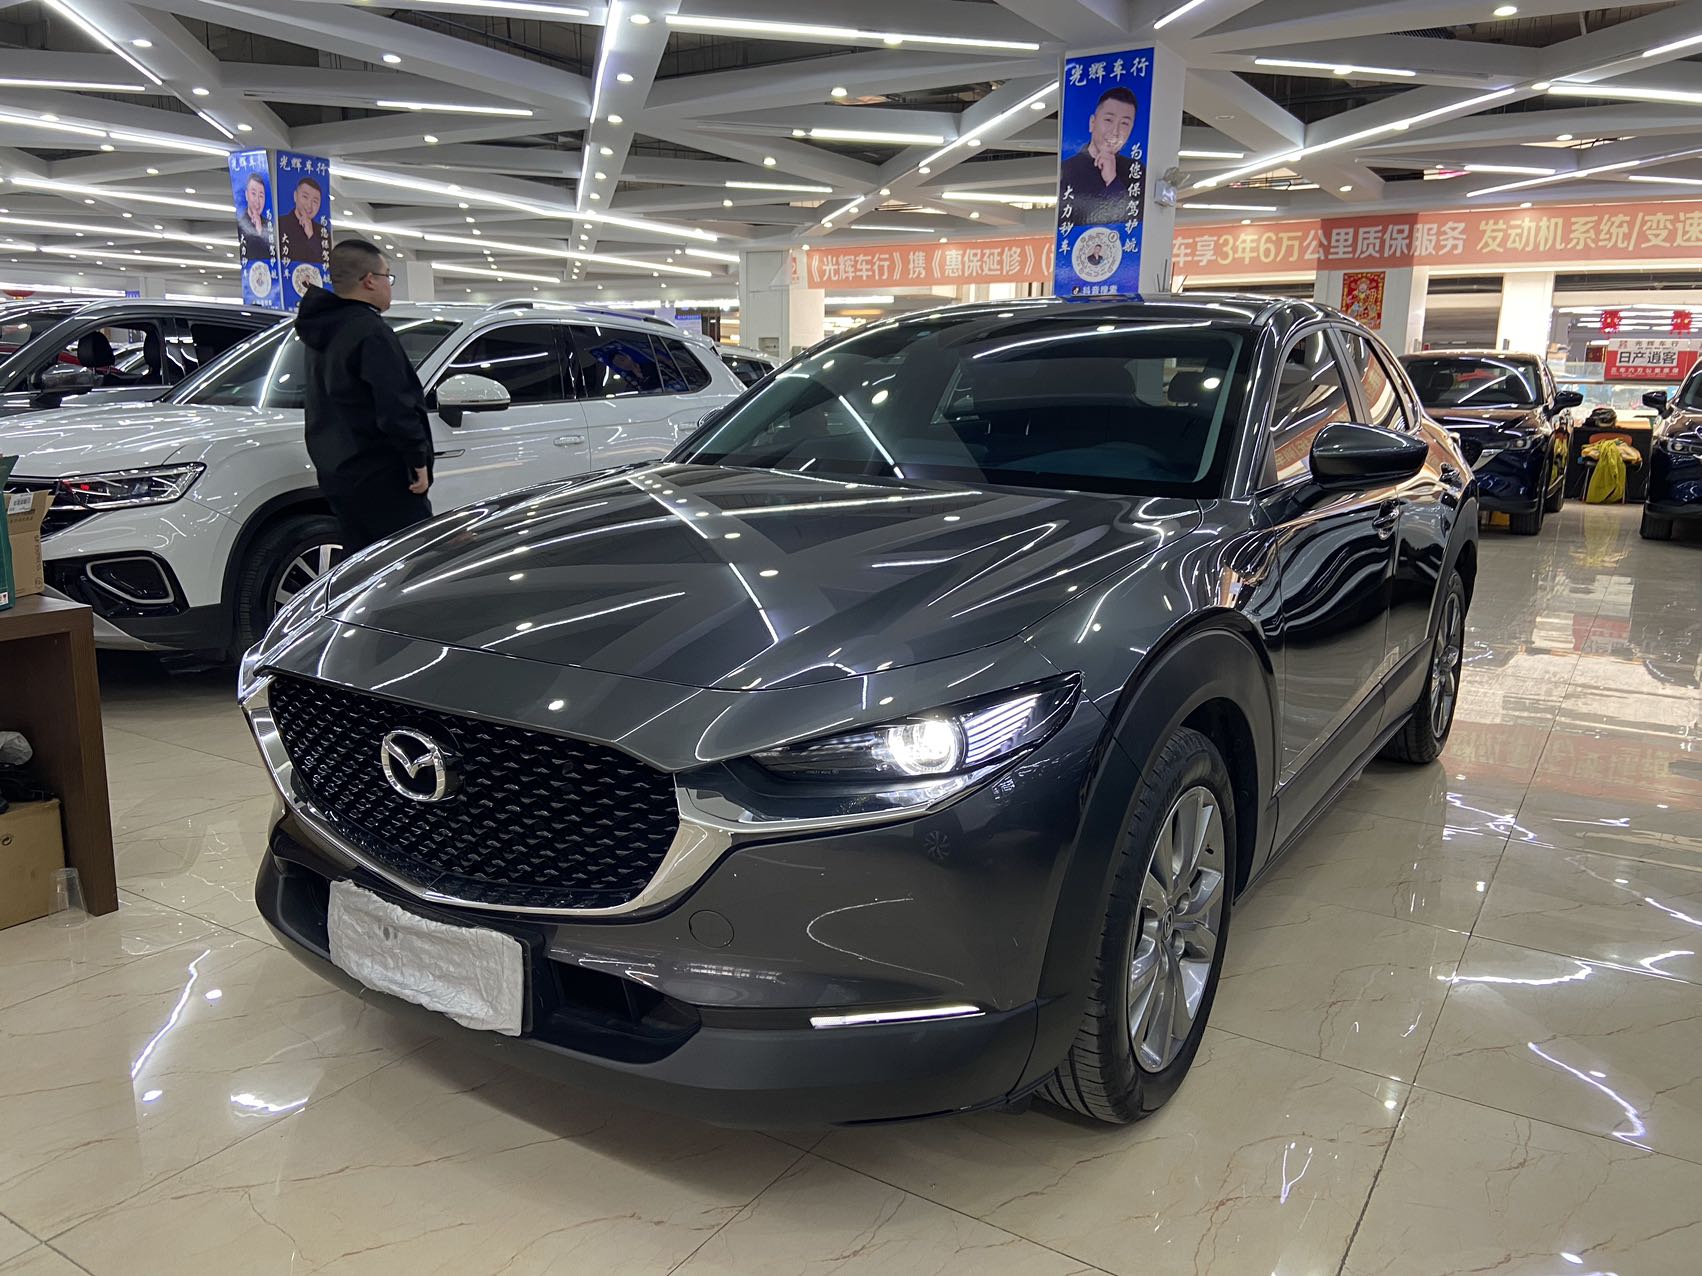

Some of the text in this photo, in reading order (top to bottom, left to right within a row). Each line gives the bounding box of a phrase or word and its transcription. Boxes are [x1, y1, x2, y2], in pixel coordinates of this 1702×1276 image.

[1068, 57, 1149, 86] 光辉车行
[280, 155, 329, 176] 光辉车行
[1122, 143, 1143, 253] 为您保驾护航
[1058, 185, 1075, 255] 大力秒车
[1477, 210, 1702, 252] 发动机系统/变速
[811, 242, 1055, 282] 《光辉车行》携《惠保延修》(
[1171, 222, 1466, 267] 车享3年6万公里质保服务
[1619, 351, 1676, 365] 日产逍客
